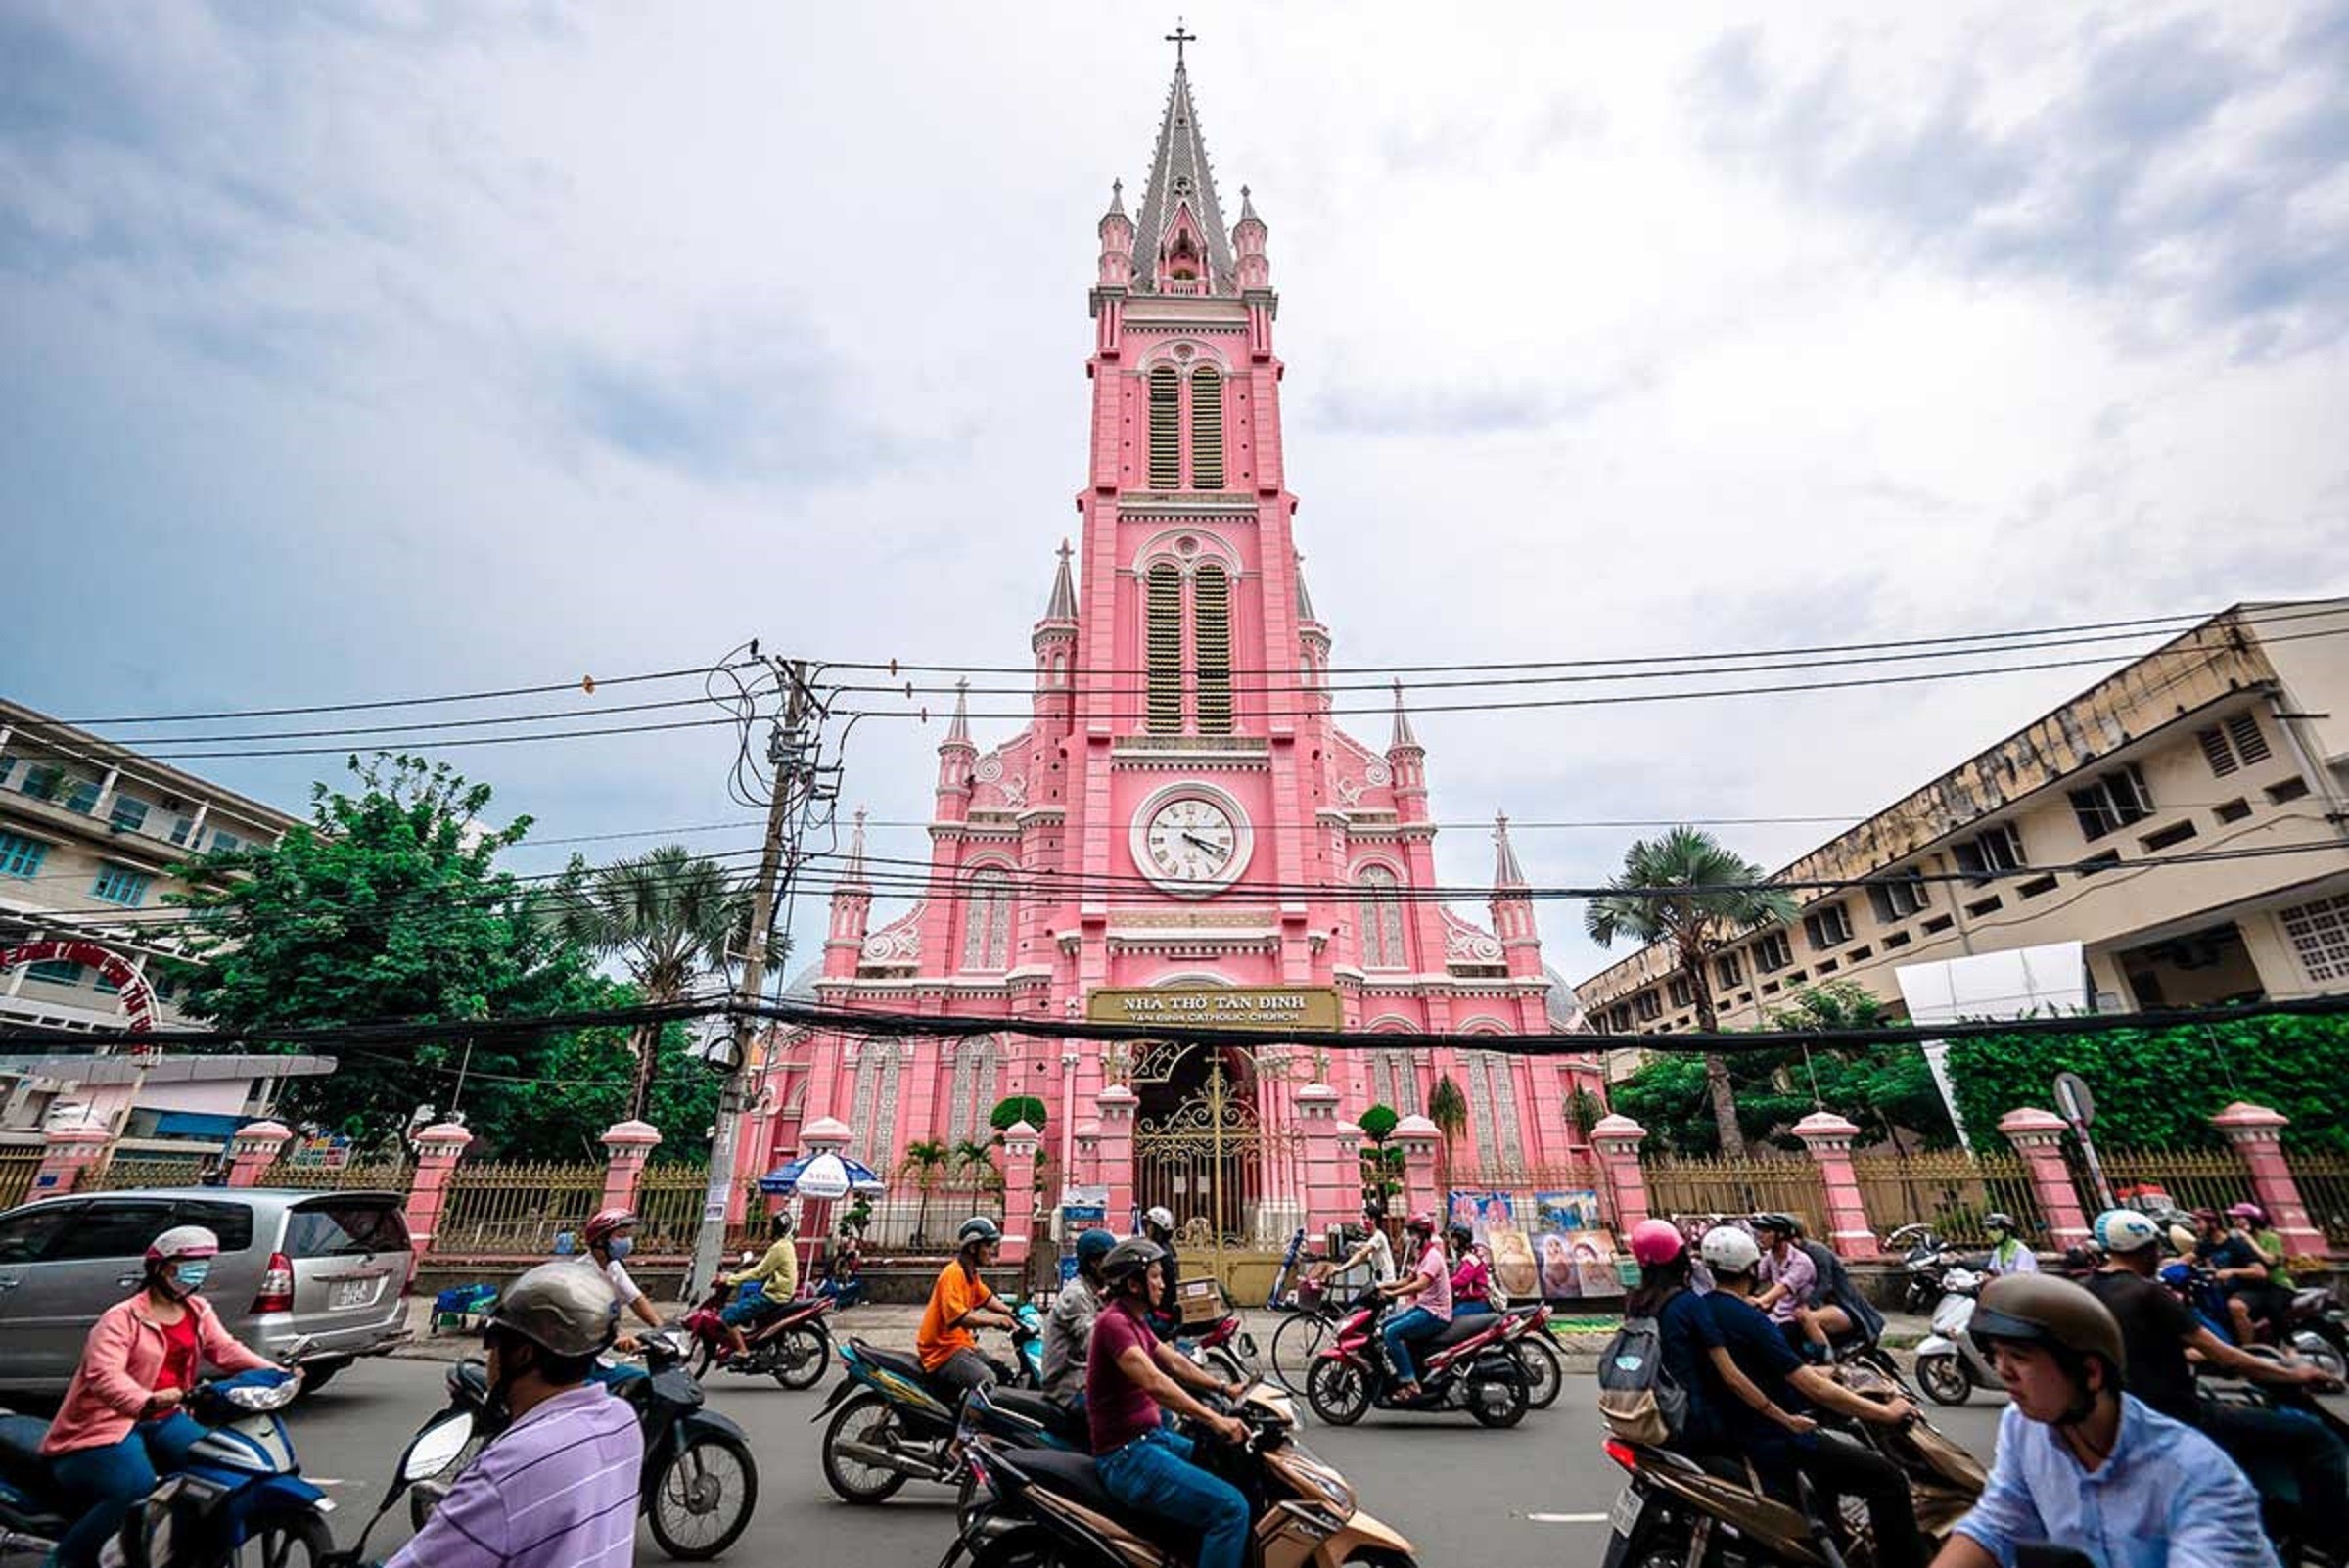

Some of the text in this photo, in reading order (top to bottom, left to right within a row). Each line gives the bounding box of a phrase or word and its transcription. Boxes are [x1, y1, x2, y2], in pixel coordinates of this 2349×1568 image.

[1124, 994, 1164, 1010] NHÀ
[1171, 993, 1209, 1009] THỜ
[1214, 993, 1252, 1009] TÂN
[1187, 1012, 1245, 1022] CATHOLIC
[1249, 1011, 1299, 1021] CHURCH
